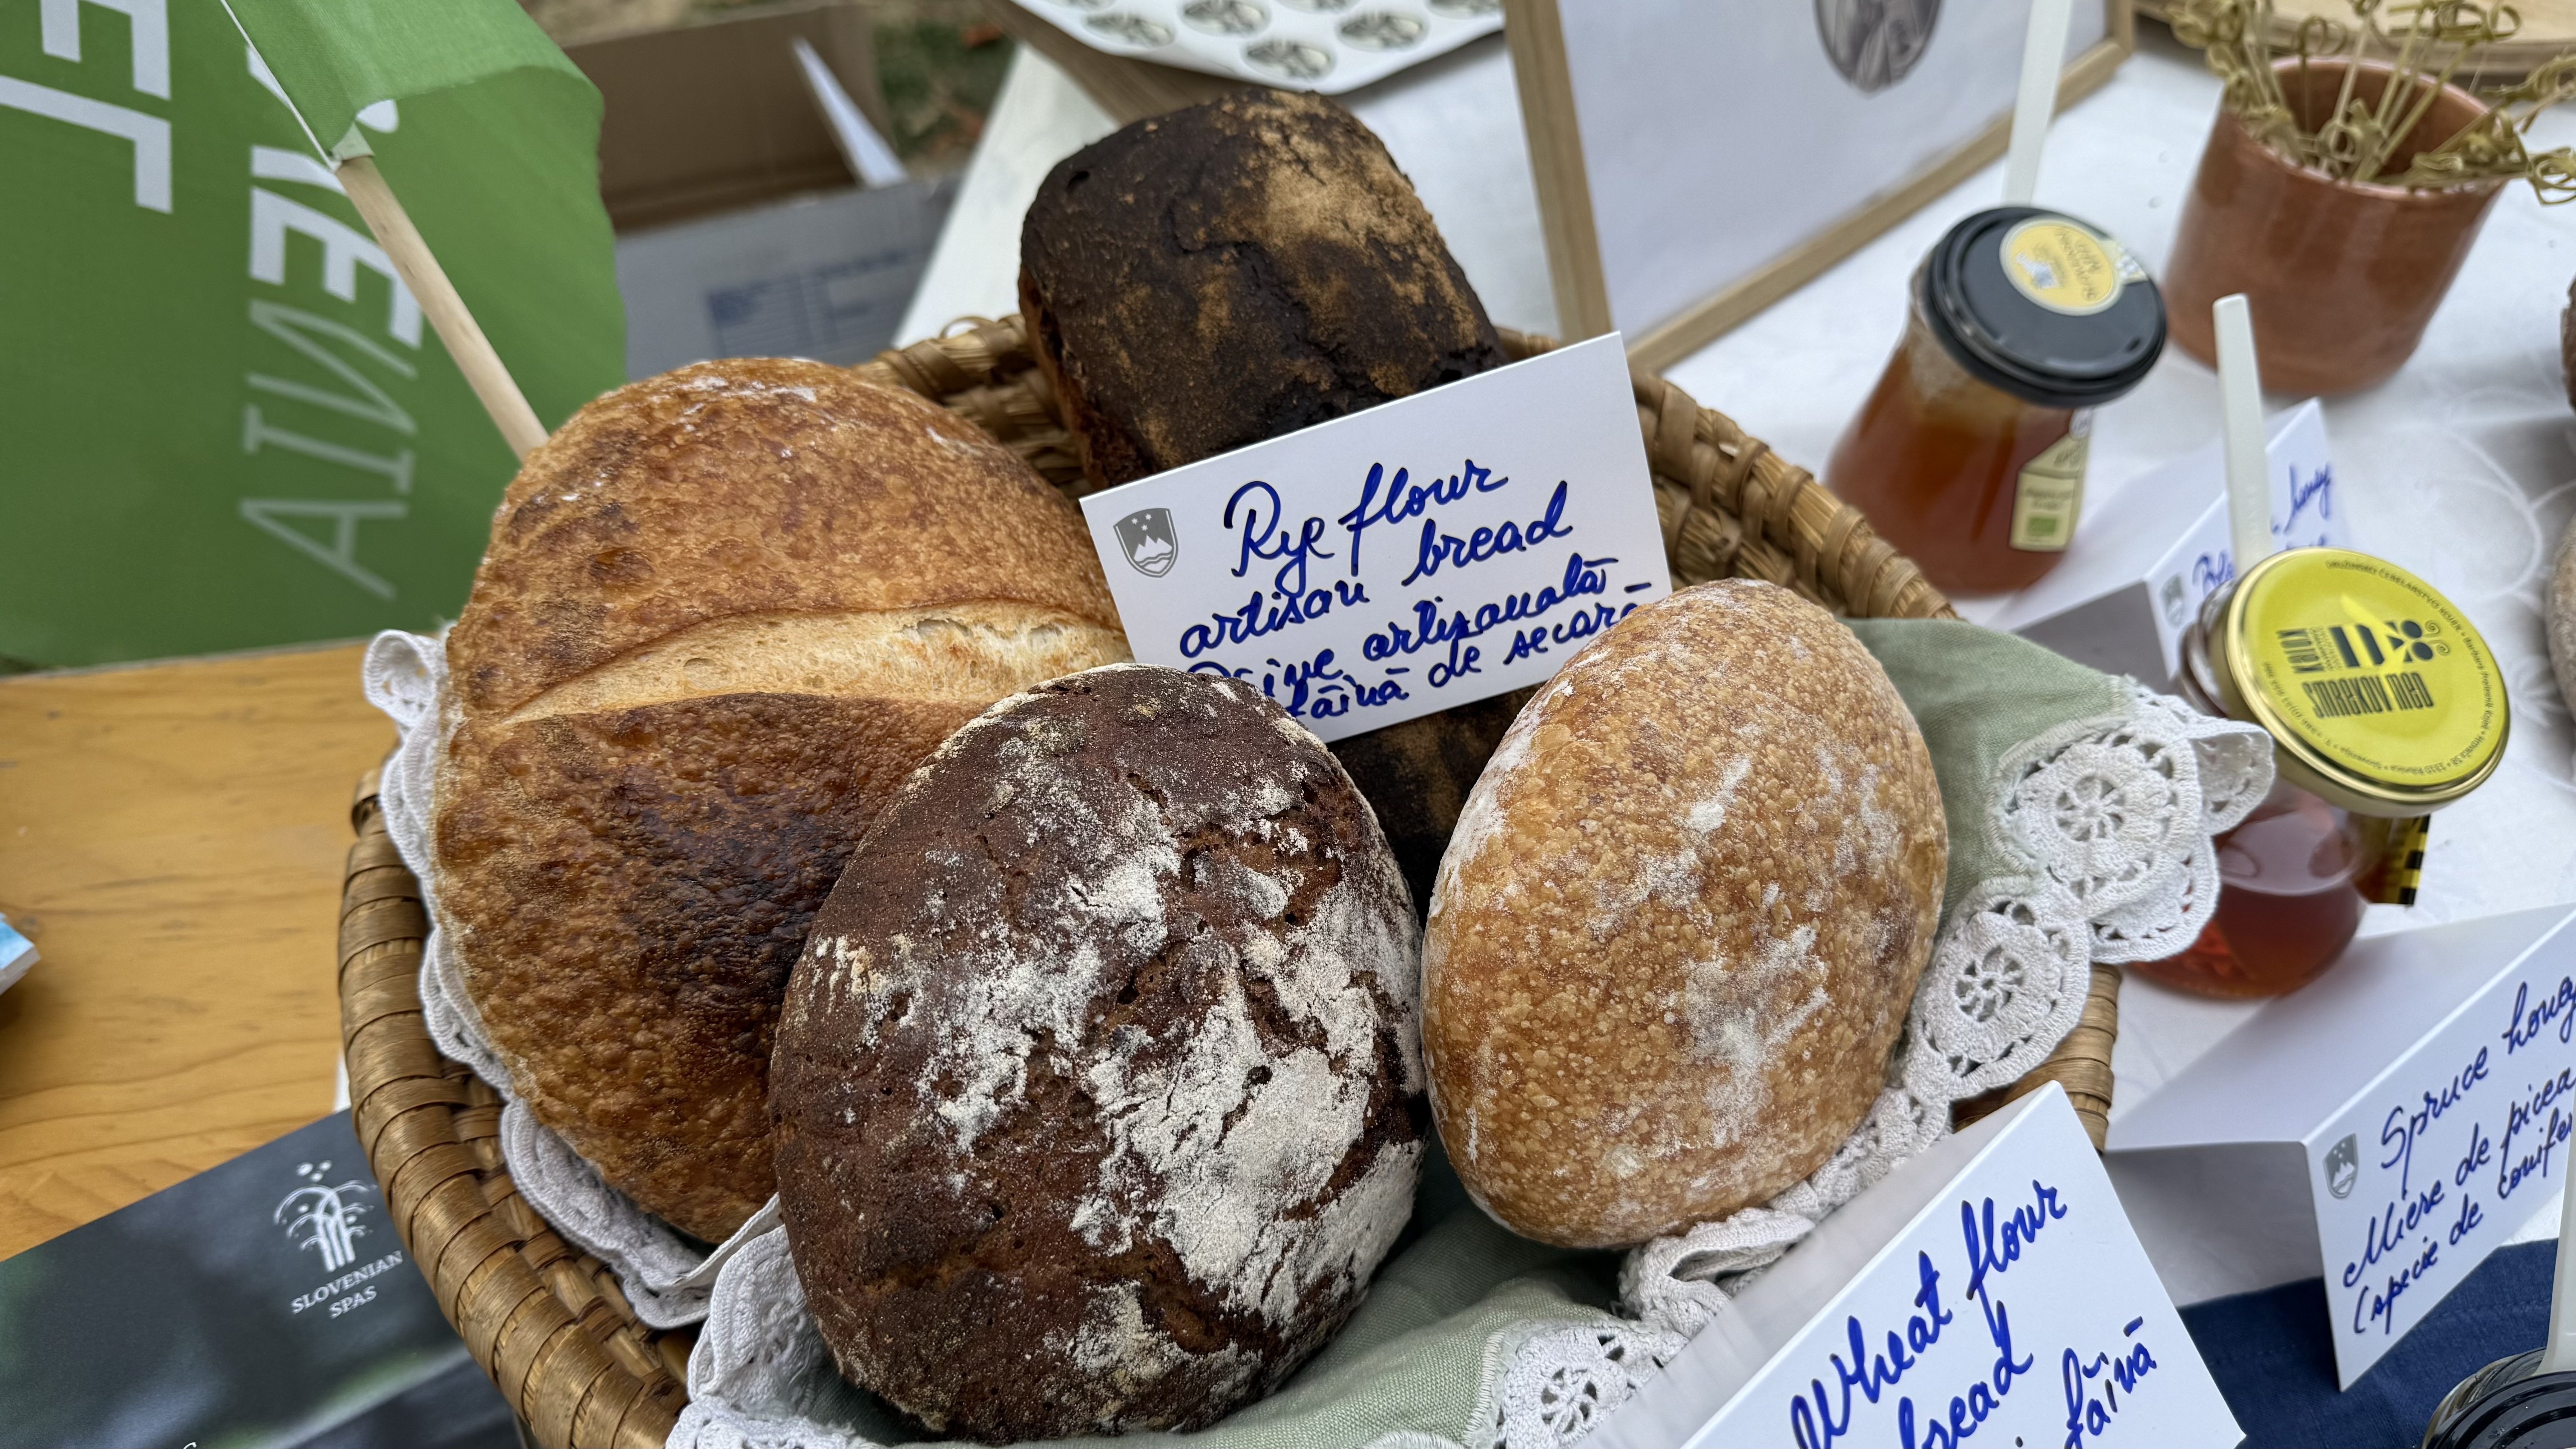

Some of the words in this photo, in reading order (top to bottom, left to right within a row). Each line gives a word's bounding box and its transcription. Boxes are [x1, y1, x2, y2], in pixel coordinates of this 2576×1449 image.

[1179, 580, 1370, 658] artisan
[1402, 481, 1573, 586] bread
[1224, 481, 1334, 594] Rye
[1339, 459, 1509, 577] flour
[1187, 649, 1344, 697] ine
[1427, 636, 1482, 688] de
[2342, 1178, 2445, 1289] Miere
[2455, 1122, 2491, 1187] de
[2500, 1067, 2576, 1178] picea
[2380, 1045, 2490, 1202] Spruce
[290, 1250, 403, 1314] SLOVENIAN
[2448, 1192, 2484, 1247] de
[329, 1285, 377, 1319] SPAS
[1790, 1249, 1953, 1449] Wheat
[1960, 1178, 2068, 1346] flour
[1897, 1299, 2034, 1449] bread
